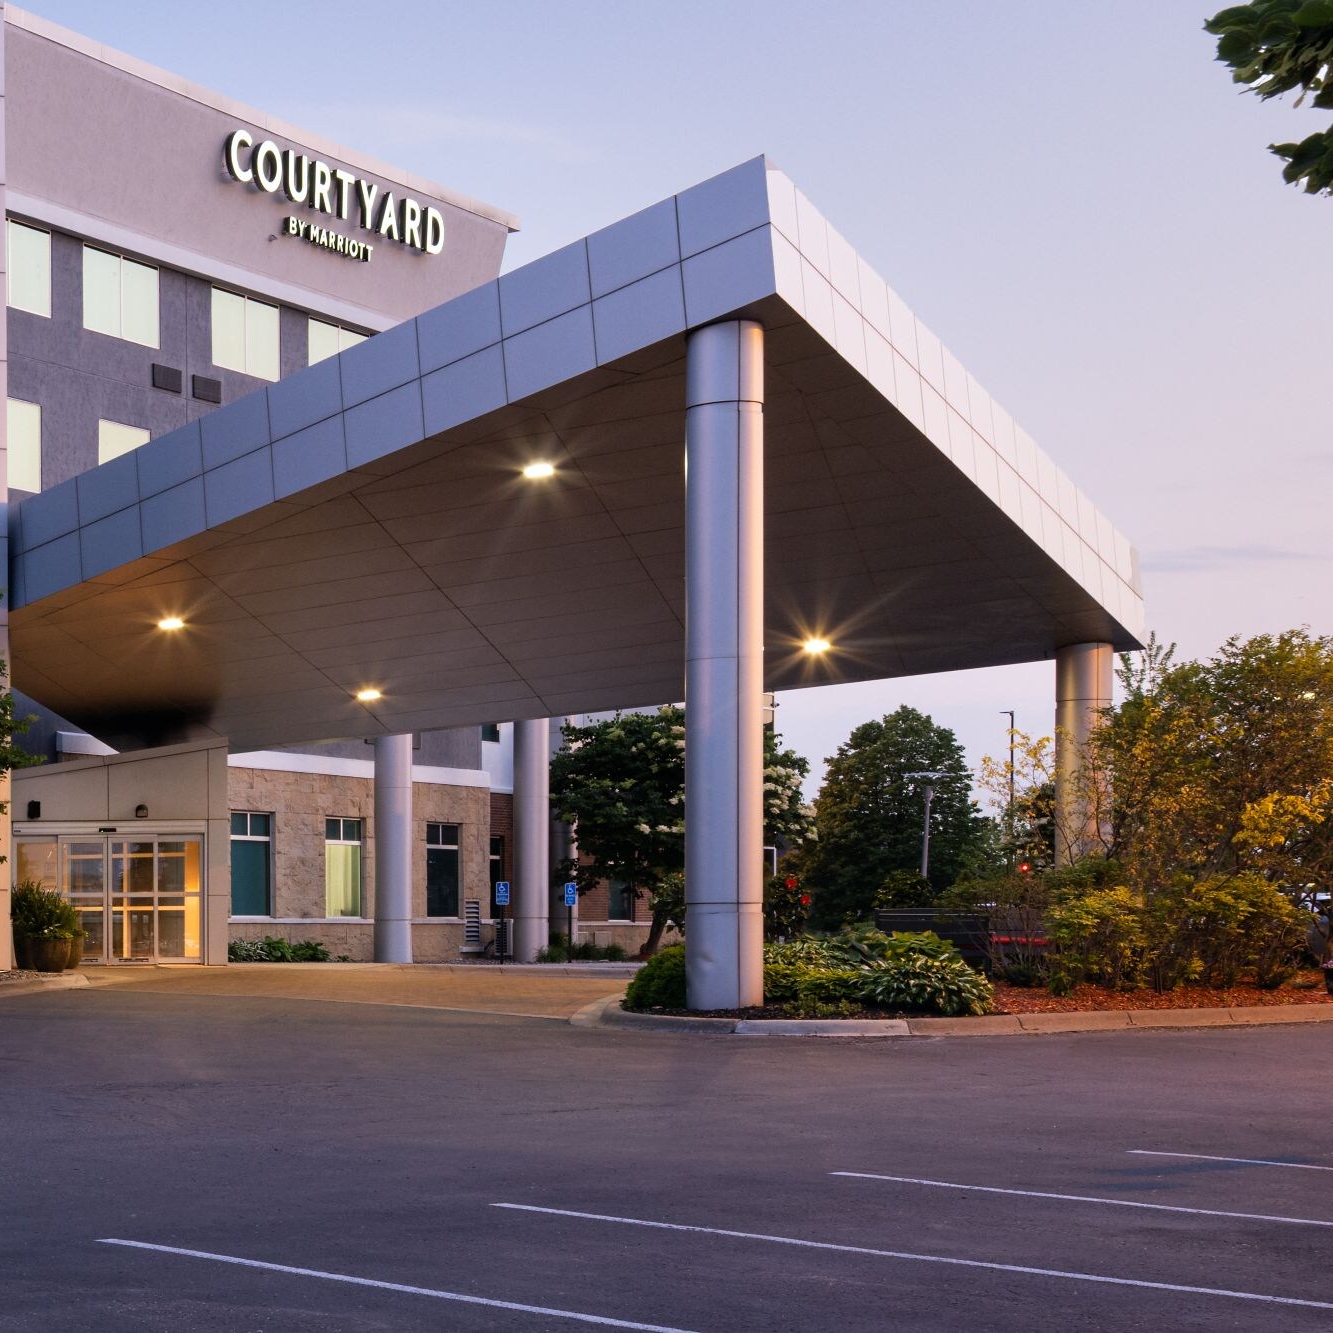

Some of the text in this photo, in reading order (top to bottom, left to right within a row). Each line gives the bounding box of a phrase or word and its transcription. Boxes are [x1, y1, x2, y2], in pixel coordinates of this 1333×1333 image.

[228, 129, 445, 256] COURTYARD
[288, 216, 374, 262] BY MARRIOTT
